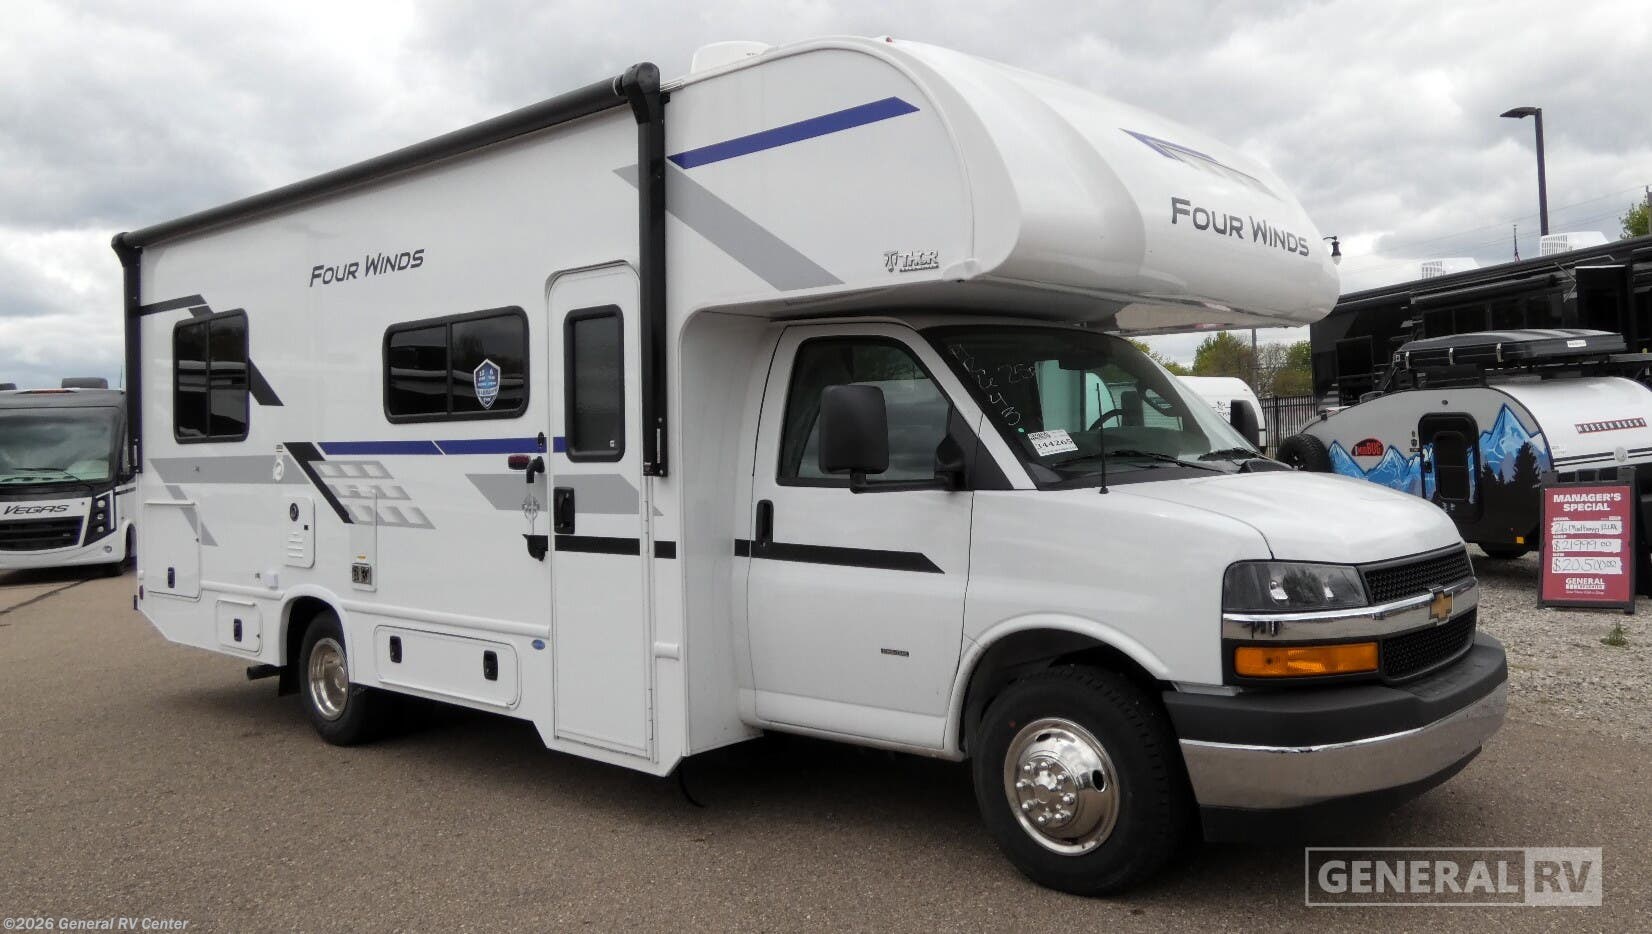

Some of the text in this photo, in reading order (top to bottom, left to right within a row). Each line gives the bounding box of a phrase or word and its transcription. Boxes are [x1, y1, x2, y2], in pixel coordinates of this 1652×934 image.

[1171, 196, 1310, 257] FOUR WINDS
[309, 248, 425, 288] FOUR WINDS
[1553, 493, 1621, 502] MANAGER'S
[3, 504, 70, 515] VEGAS
[1563, 503, 1610, 511] SPECIAL
[1565, 577, 1606, 585] GENERAL
